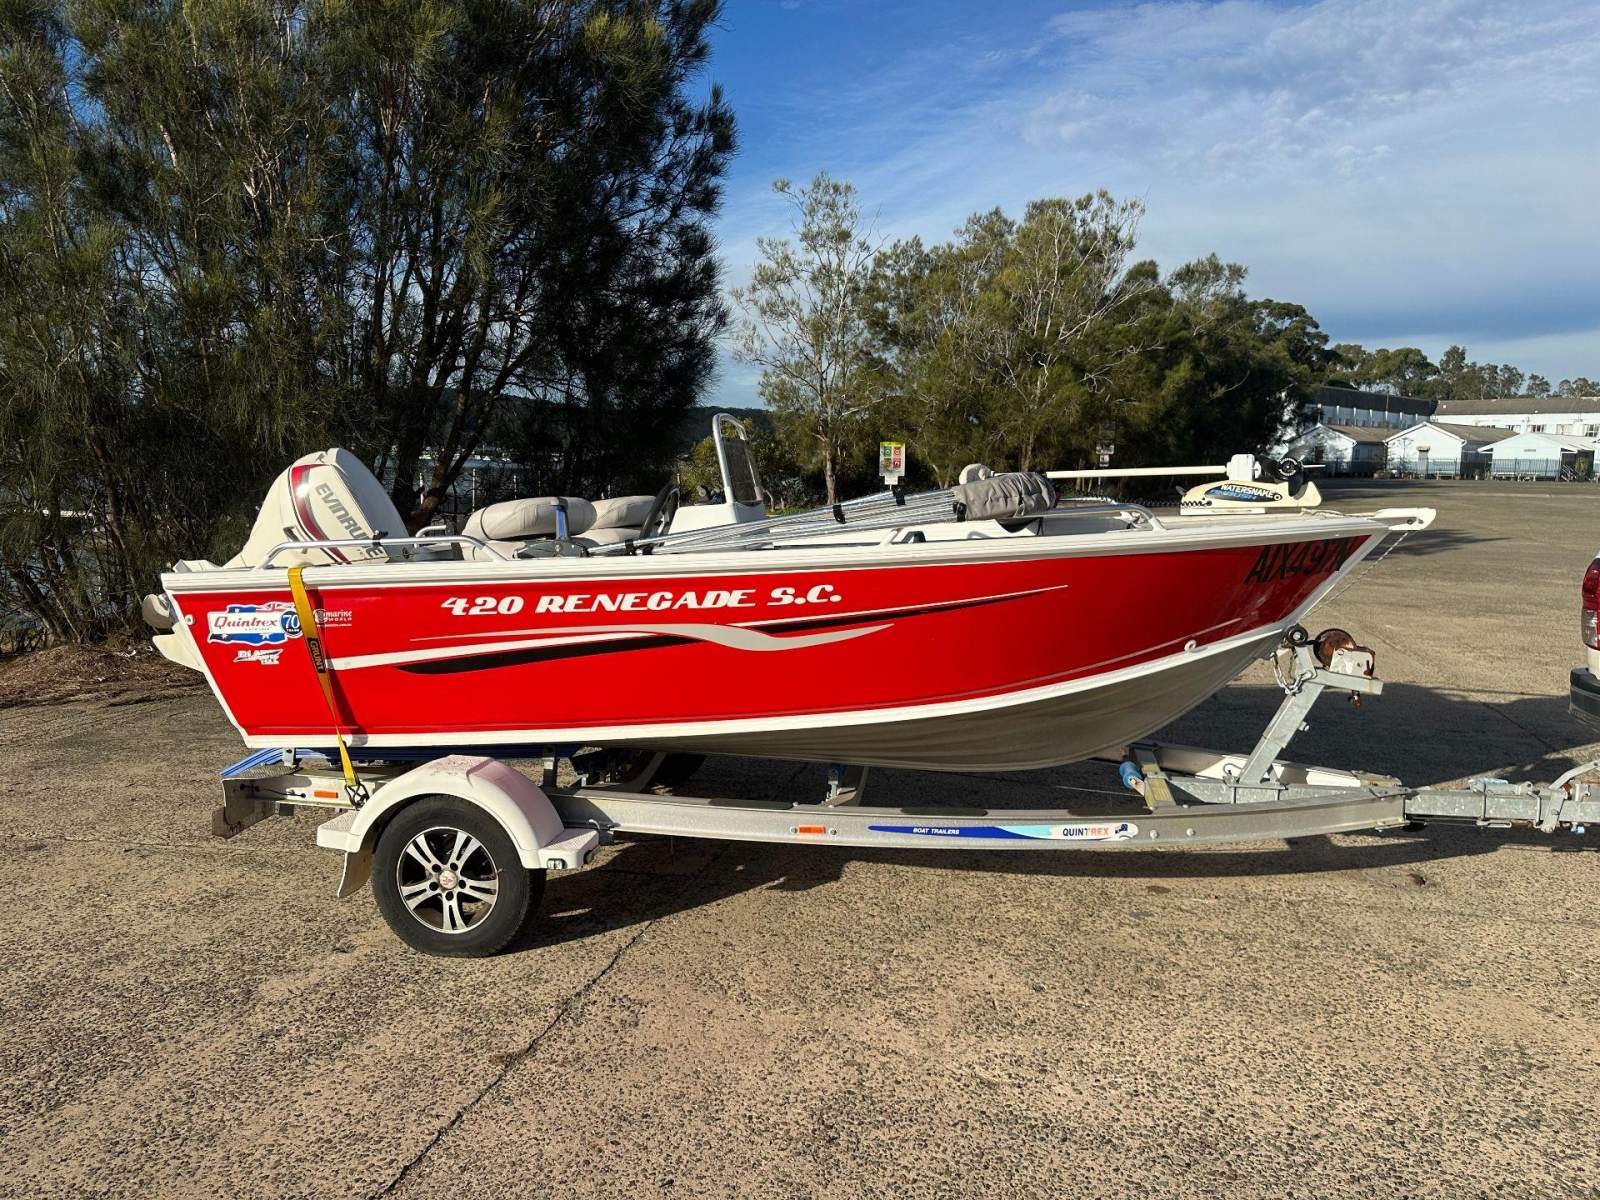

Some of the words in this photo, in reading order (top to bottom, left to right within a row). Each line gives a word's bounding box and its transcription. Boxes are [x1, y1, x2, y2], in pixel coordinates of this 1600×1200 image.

[1220, 484, 1274, 499] WATERSNAKE
[315, 483, 382, 557] EVINRUE
[440, 595, 525, 616] 420
[535, 589, 756, 614] RENEGADE
[766, 584, 842, 606] S.C.
[214, 616, 279, 630] Quintrex
[282, 614, 300, 629] 70
[1062, 827, 1109, 837] QUINTREX
